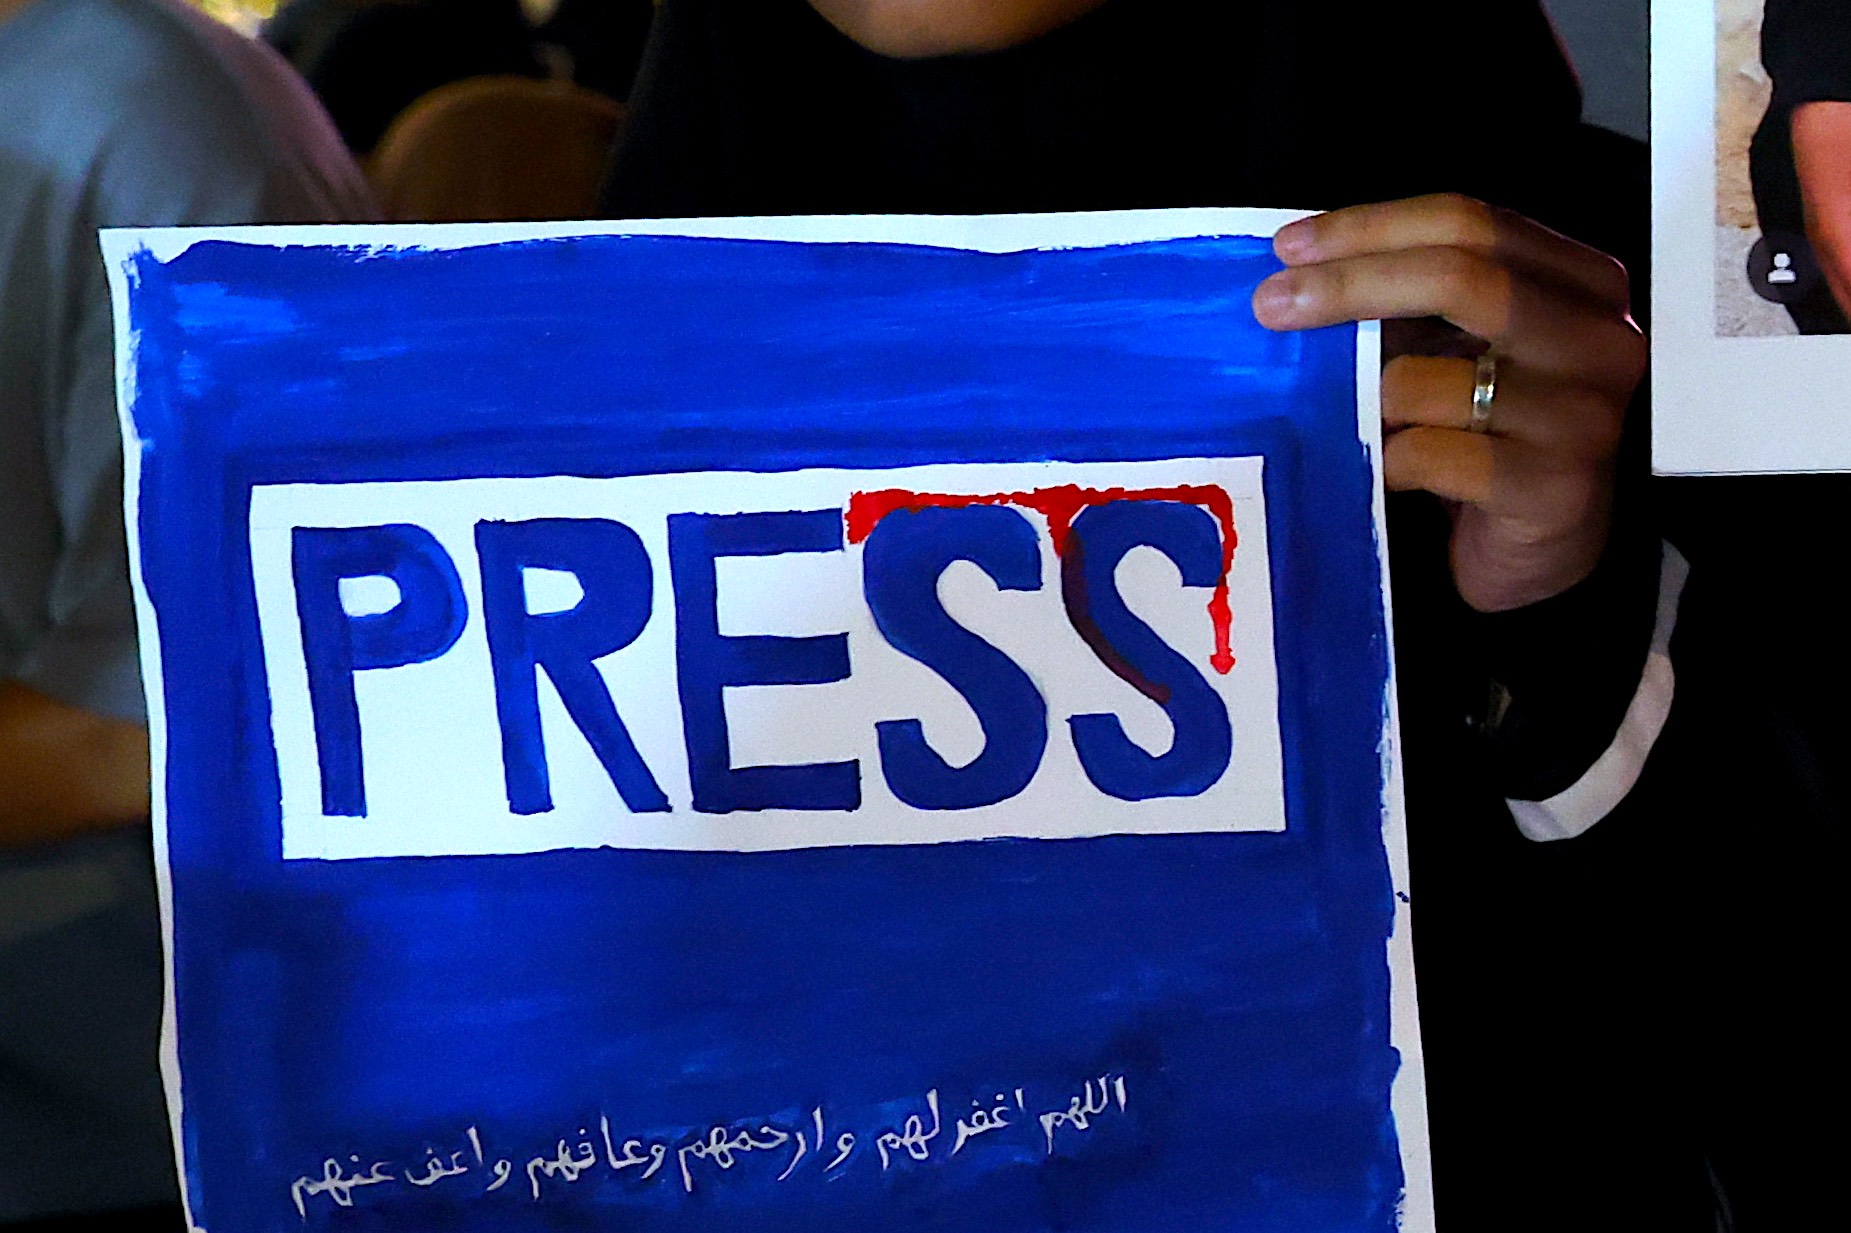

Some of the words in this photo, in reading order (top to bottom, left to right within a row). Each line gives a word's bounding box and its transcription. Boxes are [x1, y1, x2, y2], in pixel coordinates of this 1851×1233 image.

[290, 497, 1233, 817] PRESS
[677, 1105, 857, 1193] وارحمهم
[875, 1088, 941, 1171] لهم
[951, 1078, 1025, 1157] اغفر
[1039, 1073, 1127, 1155] اللهم
[290, 1153, 396, 1220] عنهم
[404, 1124, 513, 1192] واعف
[525, 1115, 667, 1200] وعافهم
